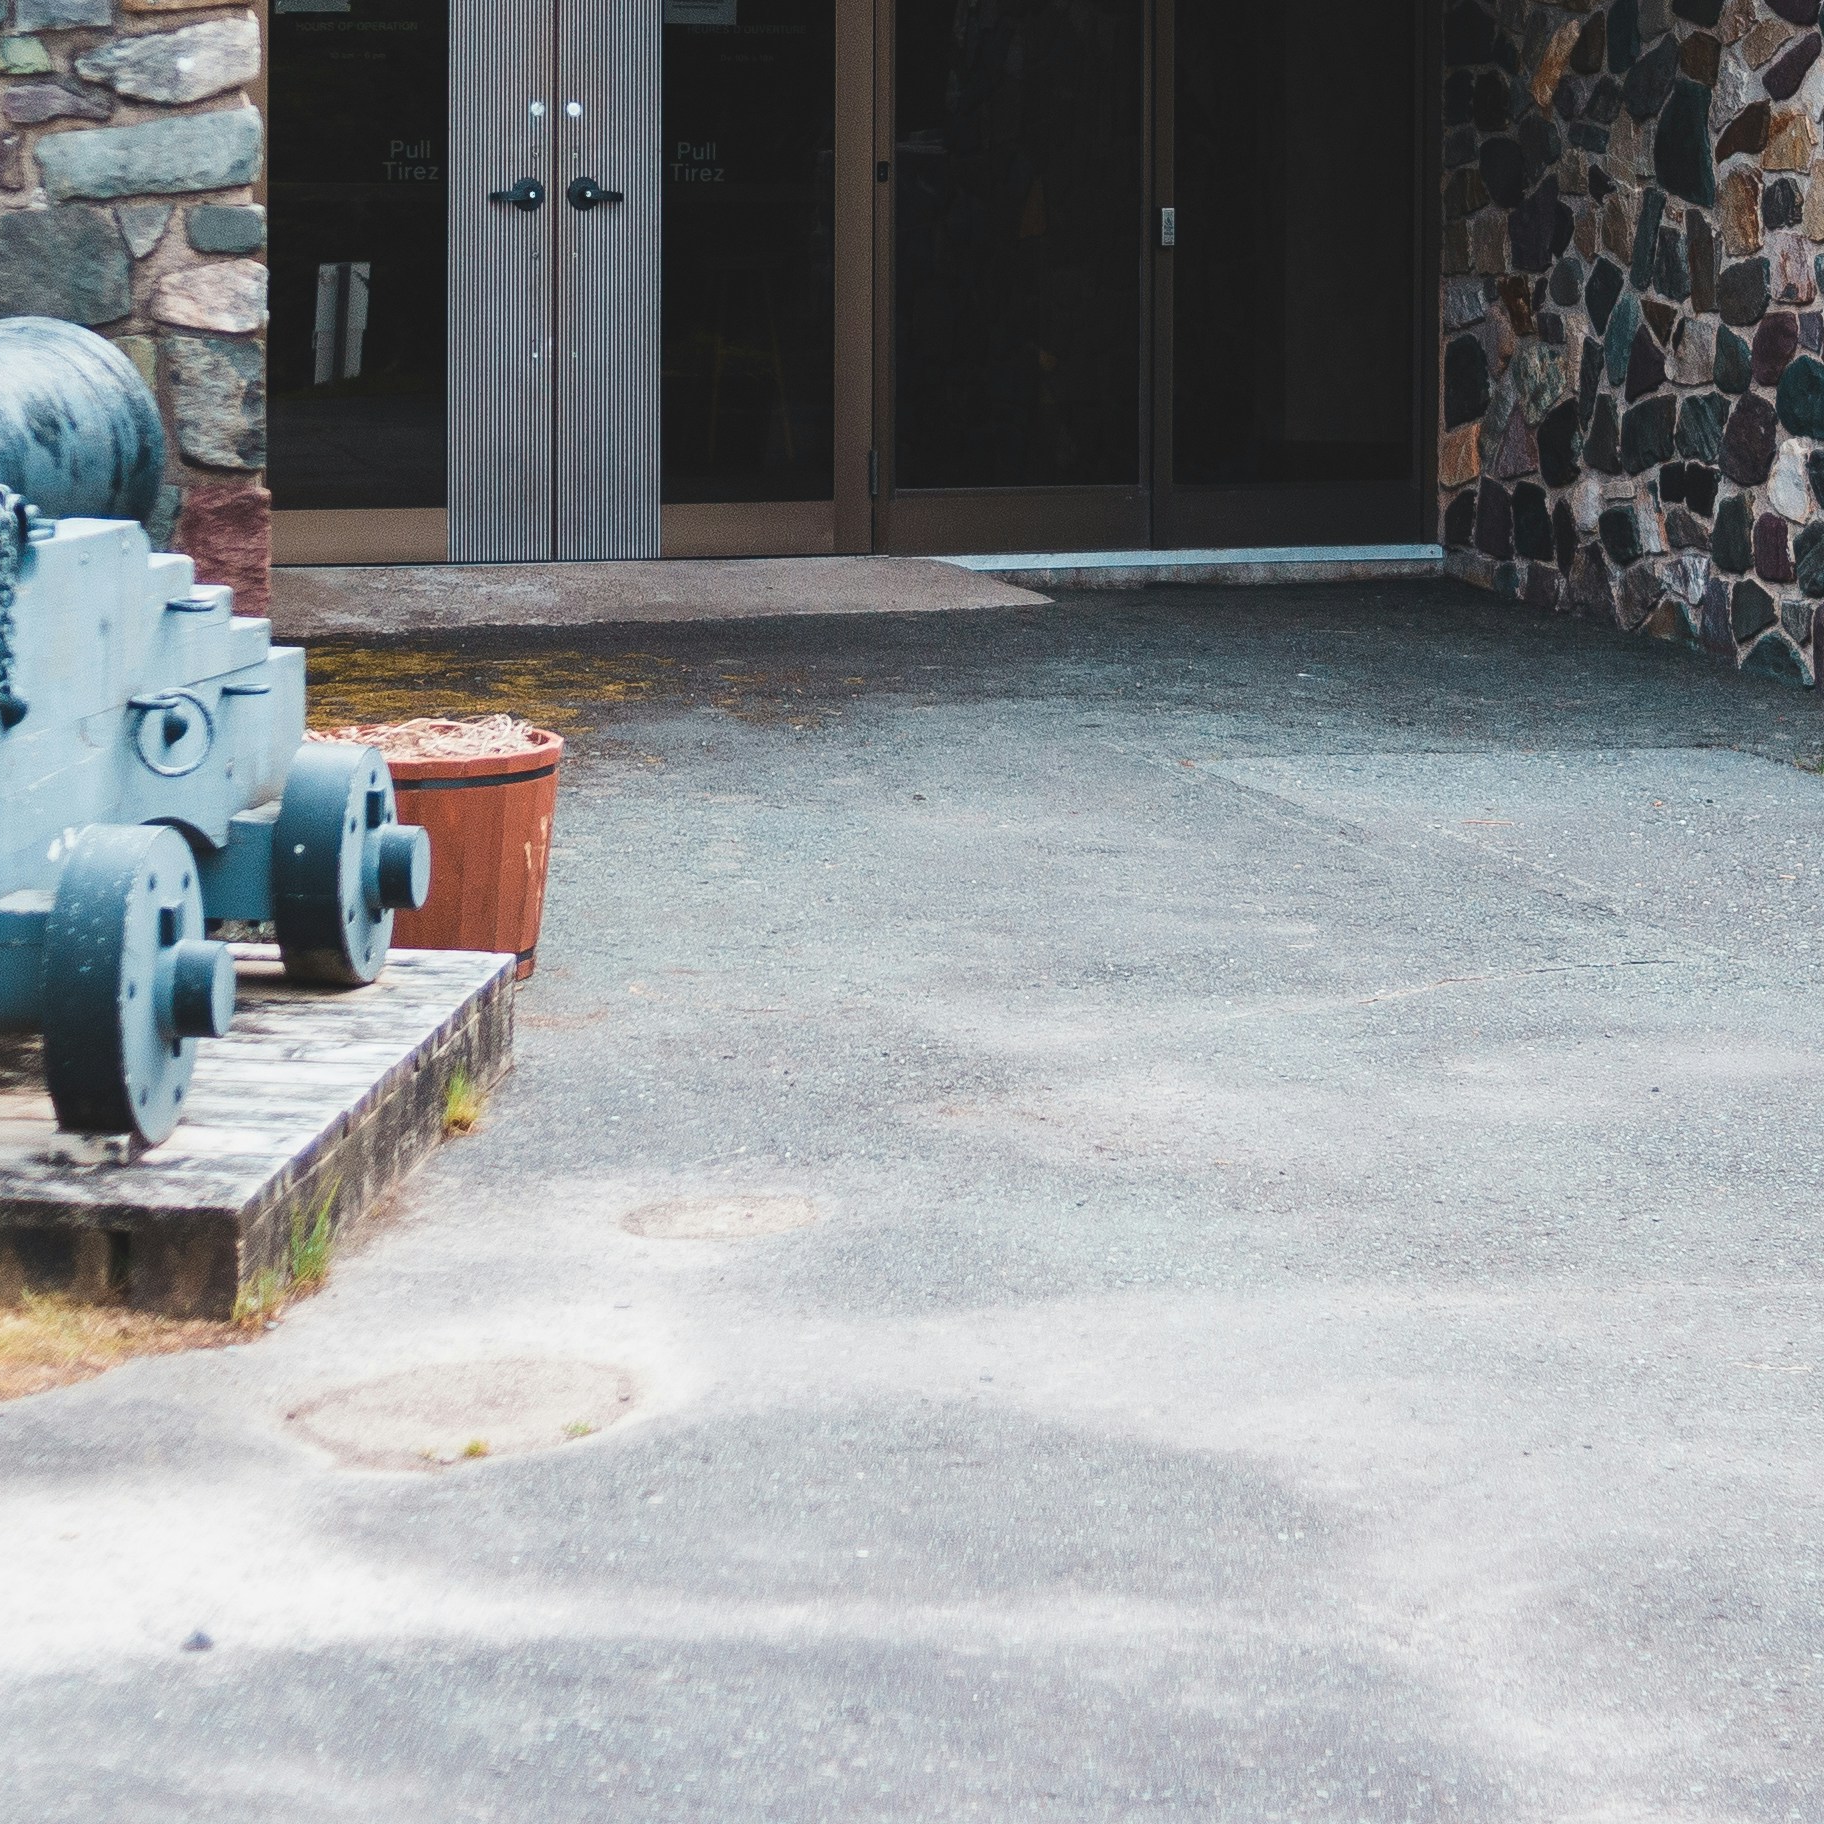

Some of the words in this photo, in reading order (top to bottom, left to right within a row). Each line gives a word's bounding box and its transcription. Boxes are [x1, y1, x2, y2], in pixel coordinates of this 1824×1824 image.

[296, 21, 335, 32] HOURS
[338, 21, 354, 31] OF
[357, 21, 418, 32] OPERATION
[389, 139, 431, 159] Pull
[677, 141, 717, 161] Pull
[382, 161, 439, 181] Tirez
[670, 163, 725, 183] Tirez
